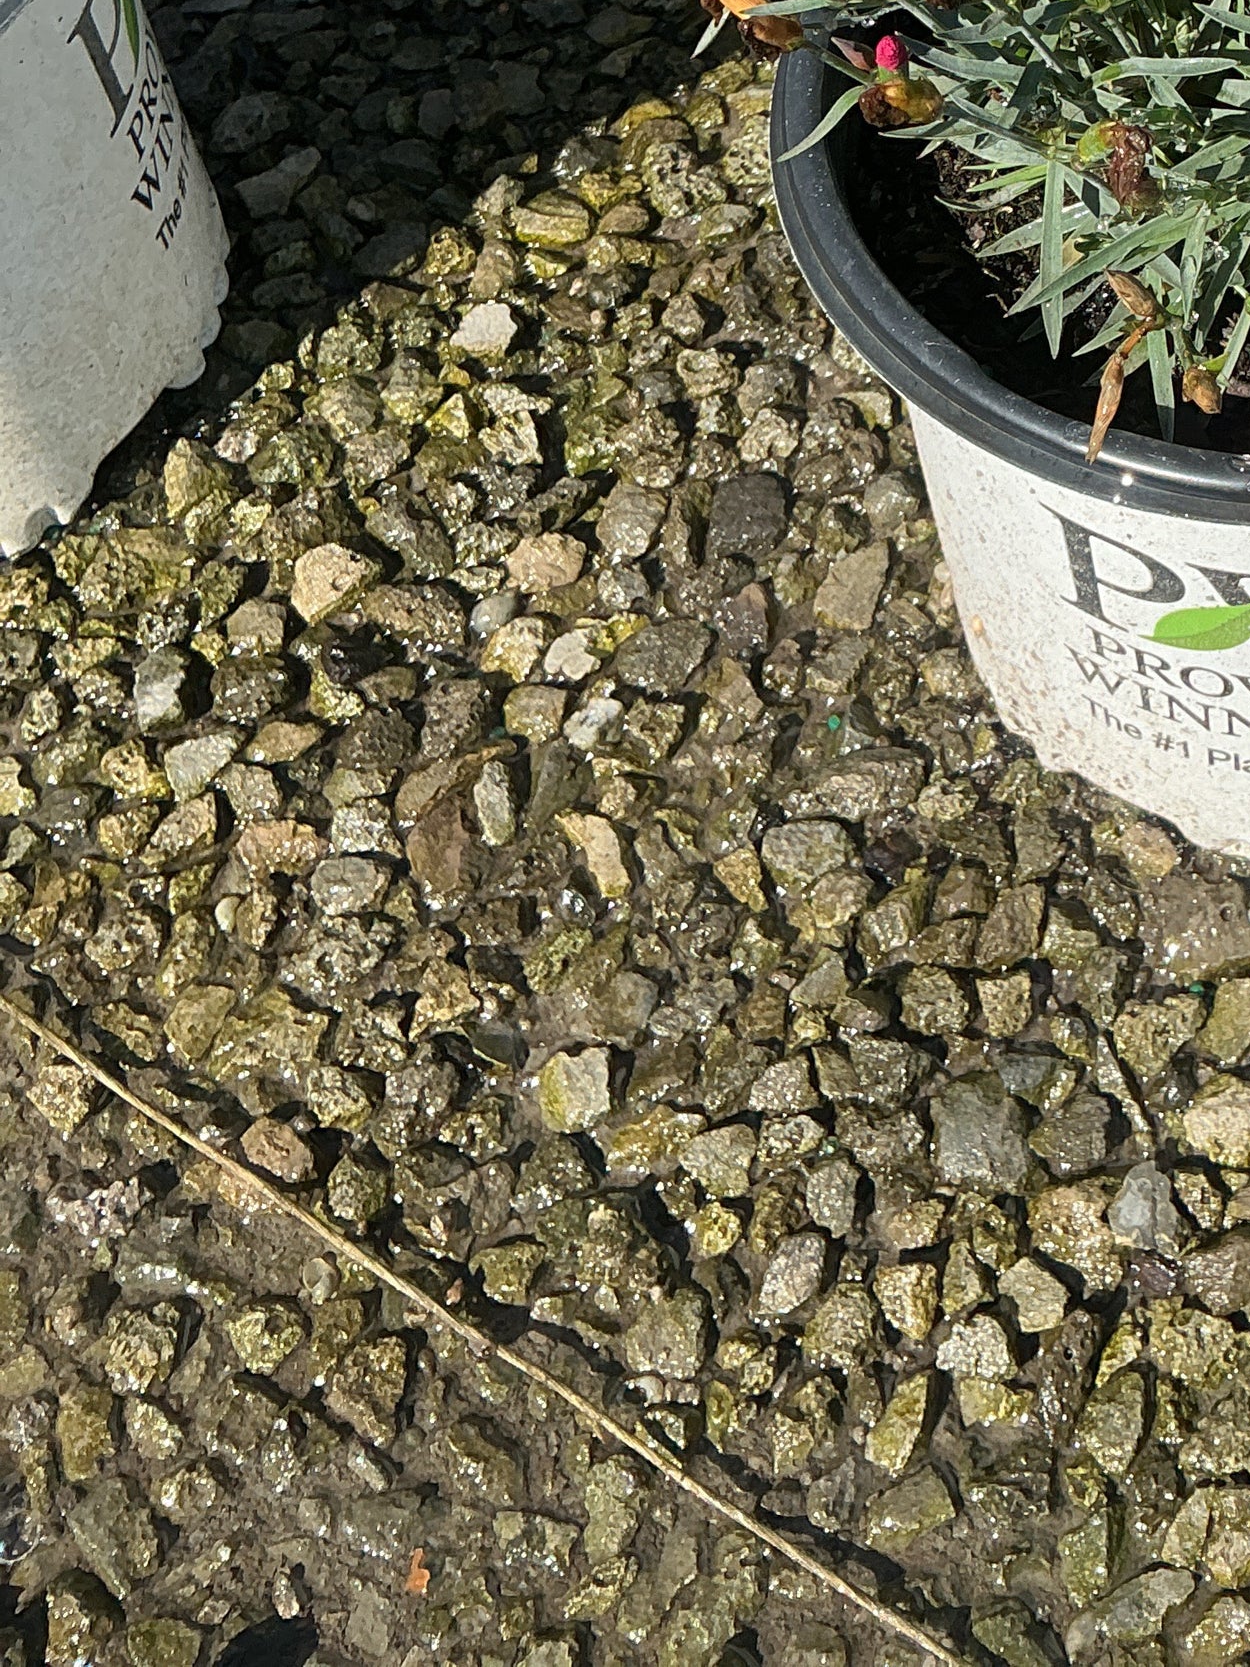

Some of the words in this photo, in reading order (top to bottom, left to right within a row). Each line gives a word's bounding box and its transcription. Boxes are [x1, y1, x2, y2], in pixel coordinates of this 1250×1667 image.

[156, 198, 182, 250] The
[1082, 694, 1143, 739] The
[1152, 731, 1190, 758] #1
